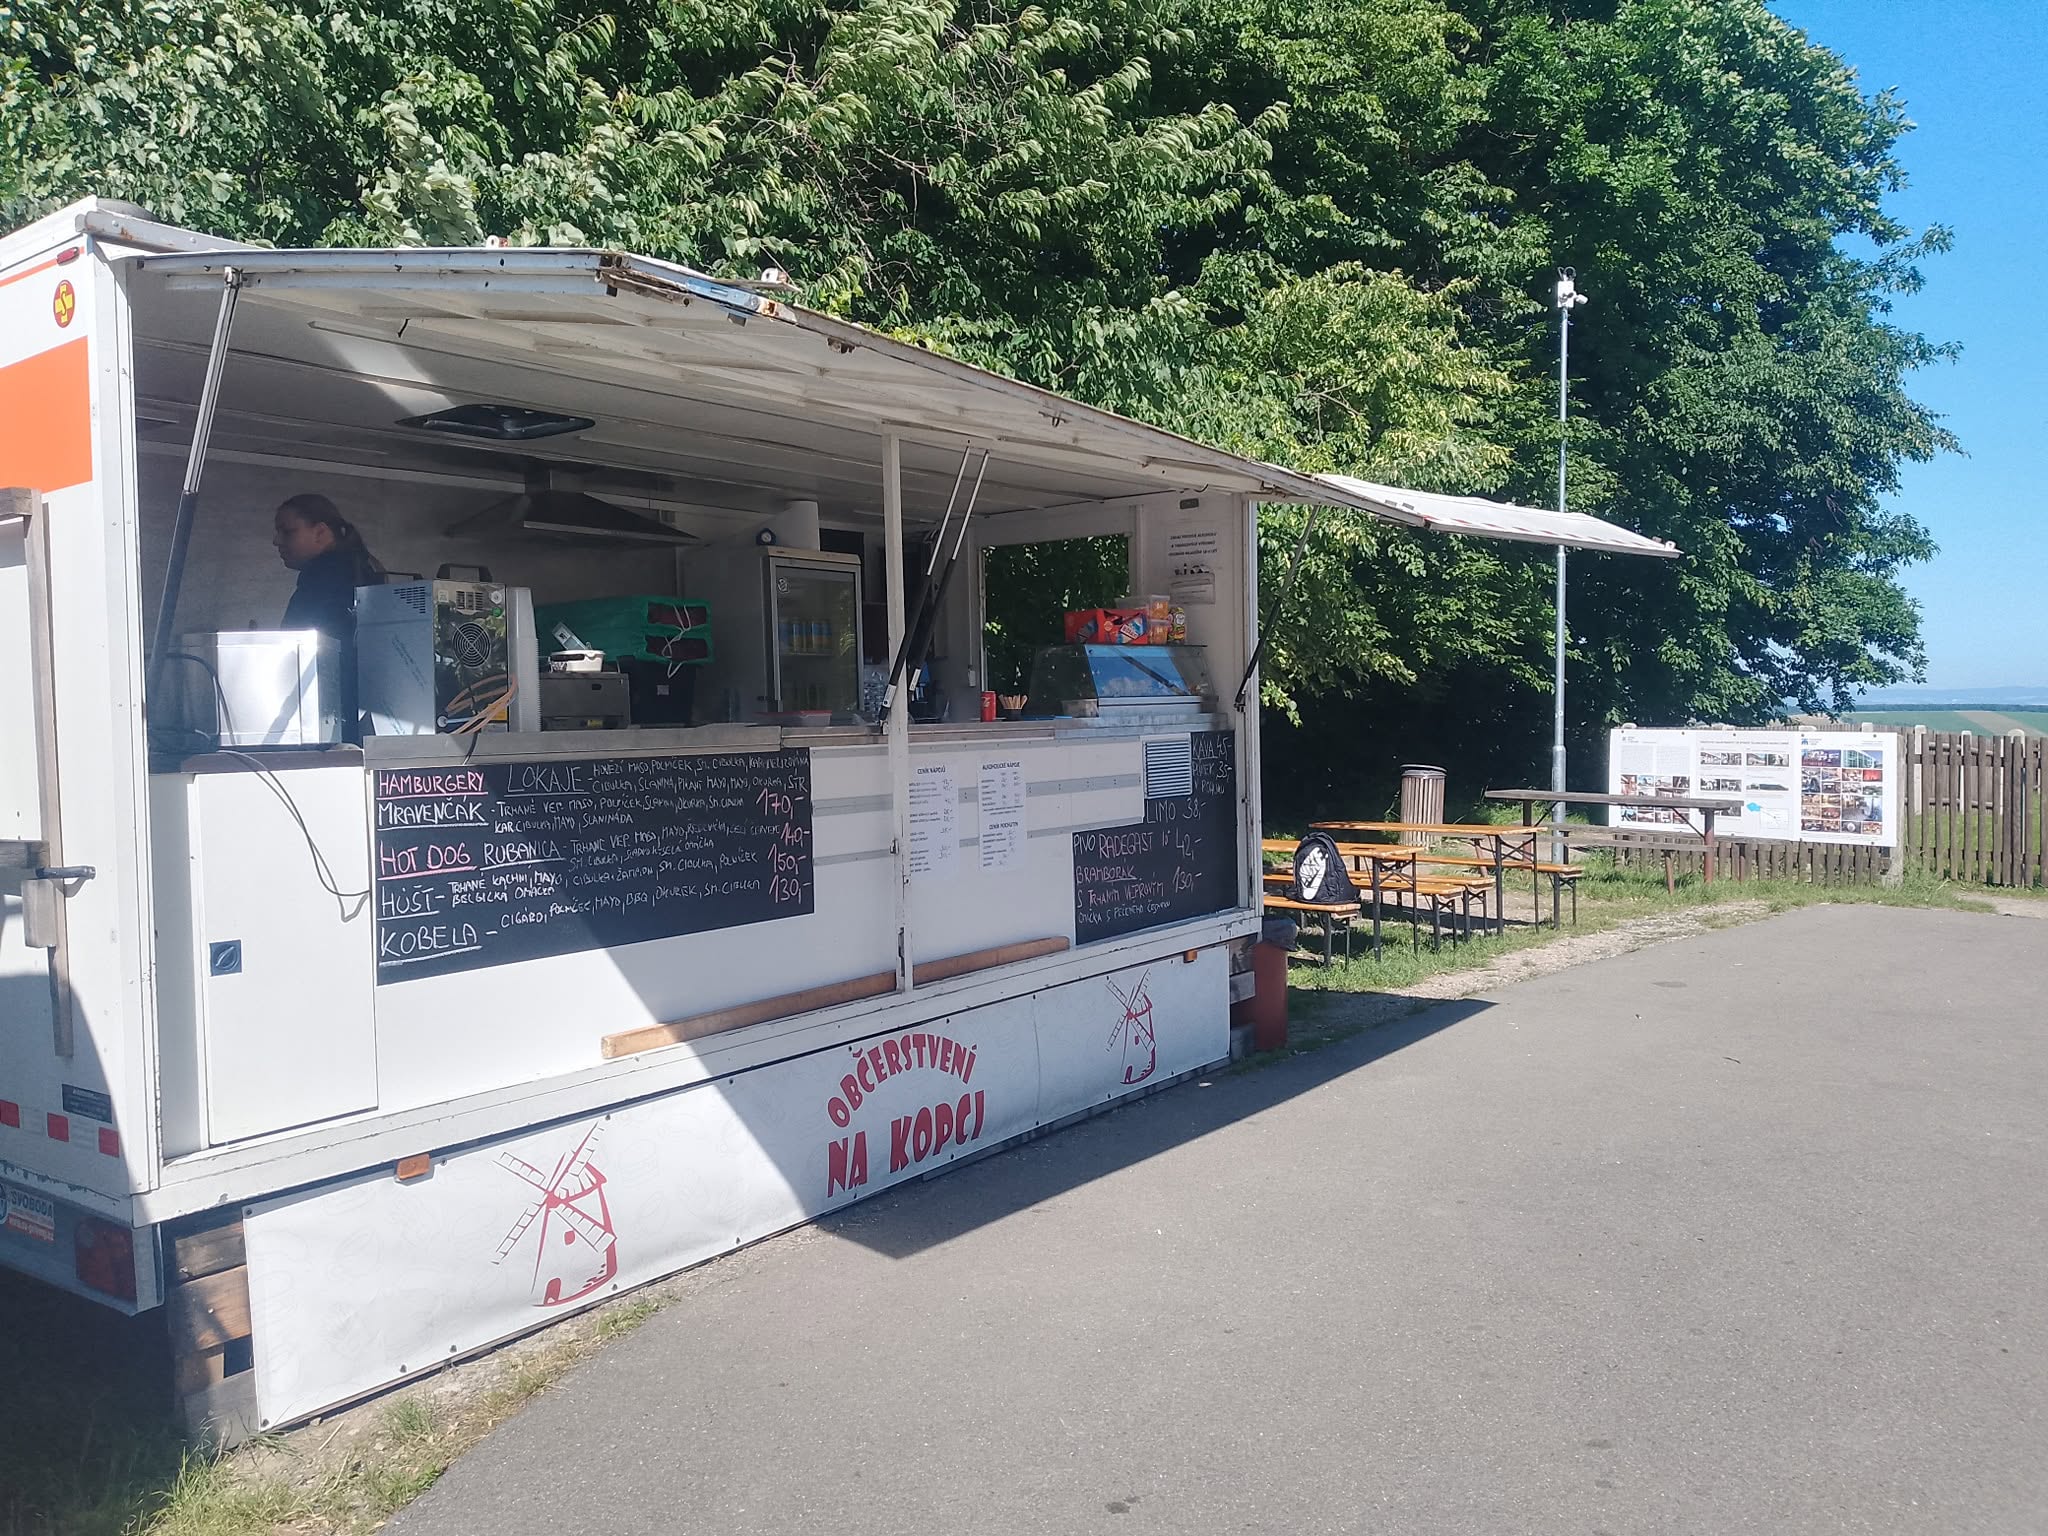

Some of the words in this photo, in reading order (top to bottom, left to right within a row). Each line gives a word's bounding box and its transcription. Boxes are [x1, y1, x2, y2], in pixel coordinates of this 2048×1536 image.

[379, 770, 485, 798] HAMBURGERY
[507, 764, 585, 792] LOKAJE
[378, 796, 486, 826] MRAVENČÁK
[582, 807, 634, 828] SLANINÁDA
[1147, 799, 1176, 823] LIMO
[380, 840, 419, 876] HOT
[427, 842, 471, 870] DOG
[483, 839, 561, 866] RUBANICA
[1073, 834, 1096, 856] PIVO
[1098, 831, 1153, 859] RADEGAST
[1075, 858, 1137, 884] BRAMBORÁK
[380, 923, 478, 957] KOBELA
[828, 1033, 978, 1128] OBČERSTVENÍ
[827, 1130, 869, 1198] NA
[889, 1089, 986, 1174] KOPCI
[10, 1190, 54, 1218] SVOBODA
